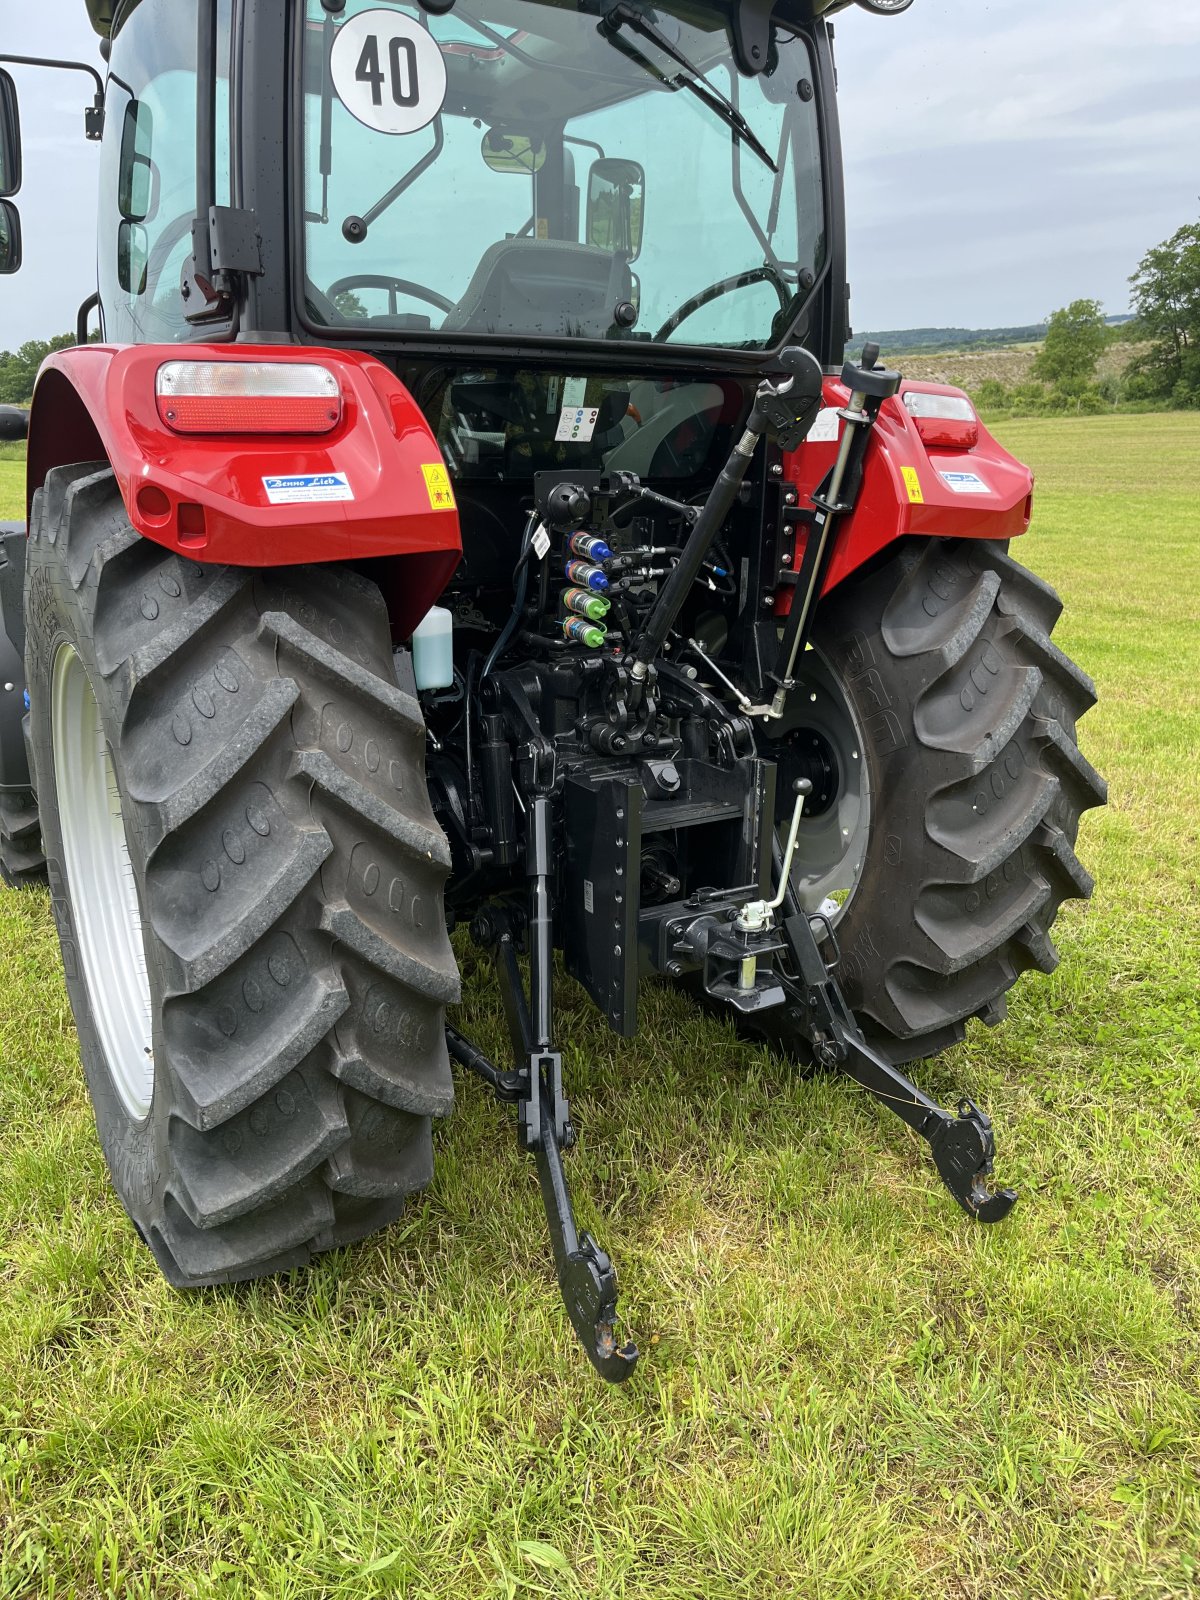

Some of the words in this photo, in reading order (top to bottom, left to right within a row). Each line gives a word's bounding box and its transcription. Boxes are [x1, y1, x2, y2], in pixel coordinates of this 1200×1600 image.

[355, 35, 420, 108] 40
[268, 479, 305, 488] Benno
[307, 477, 335, 487] Lieb
